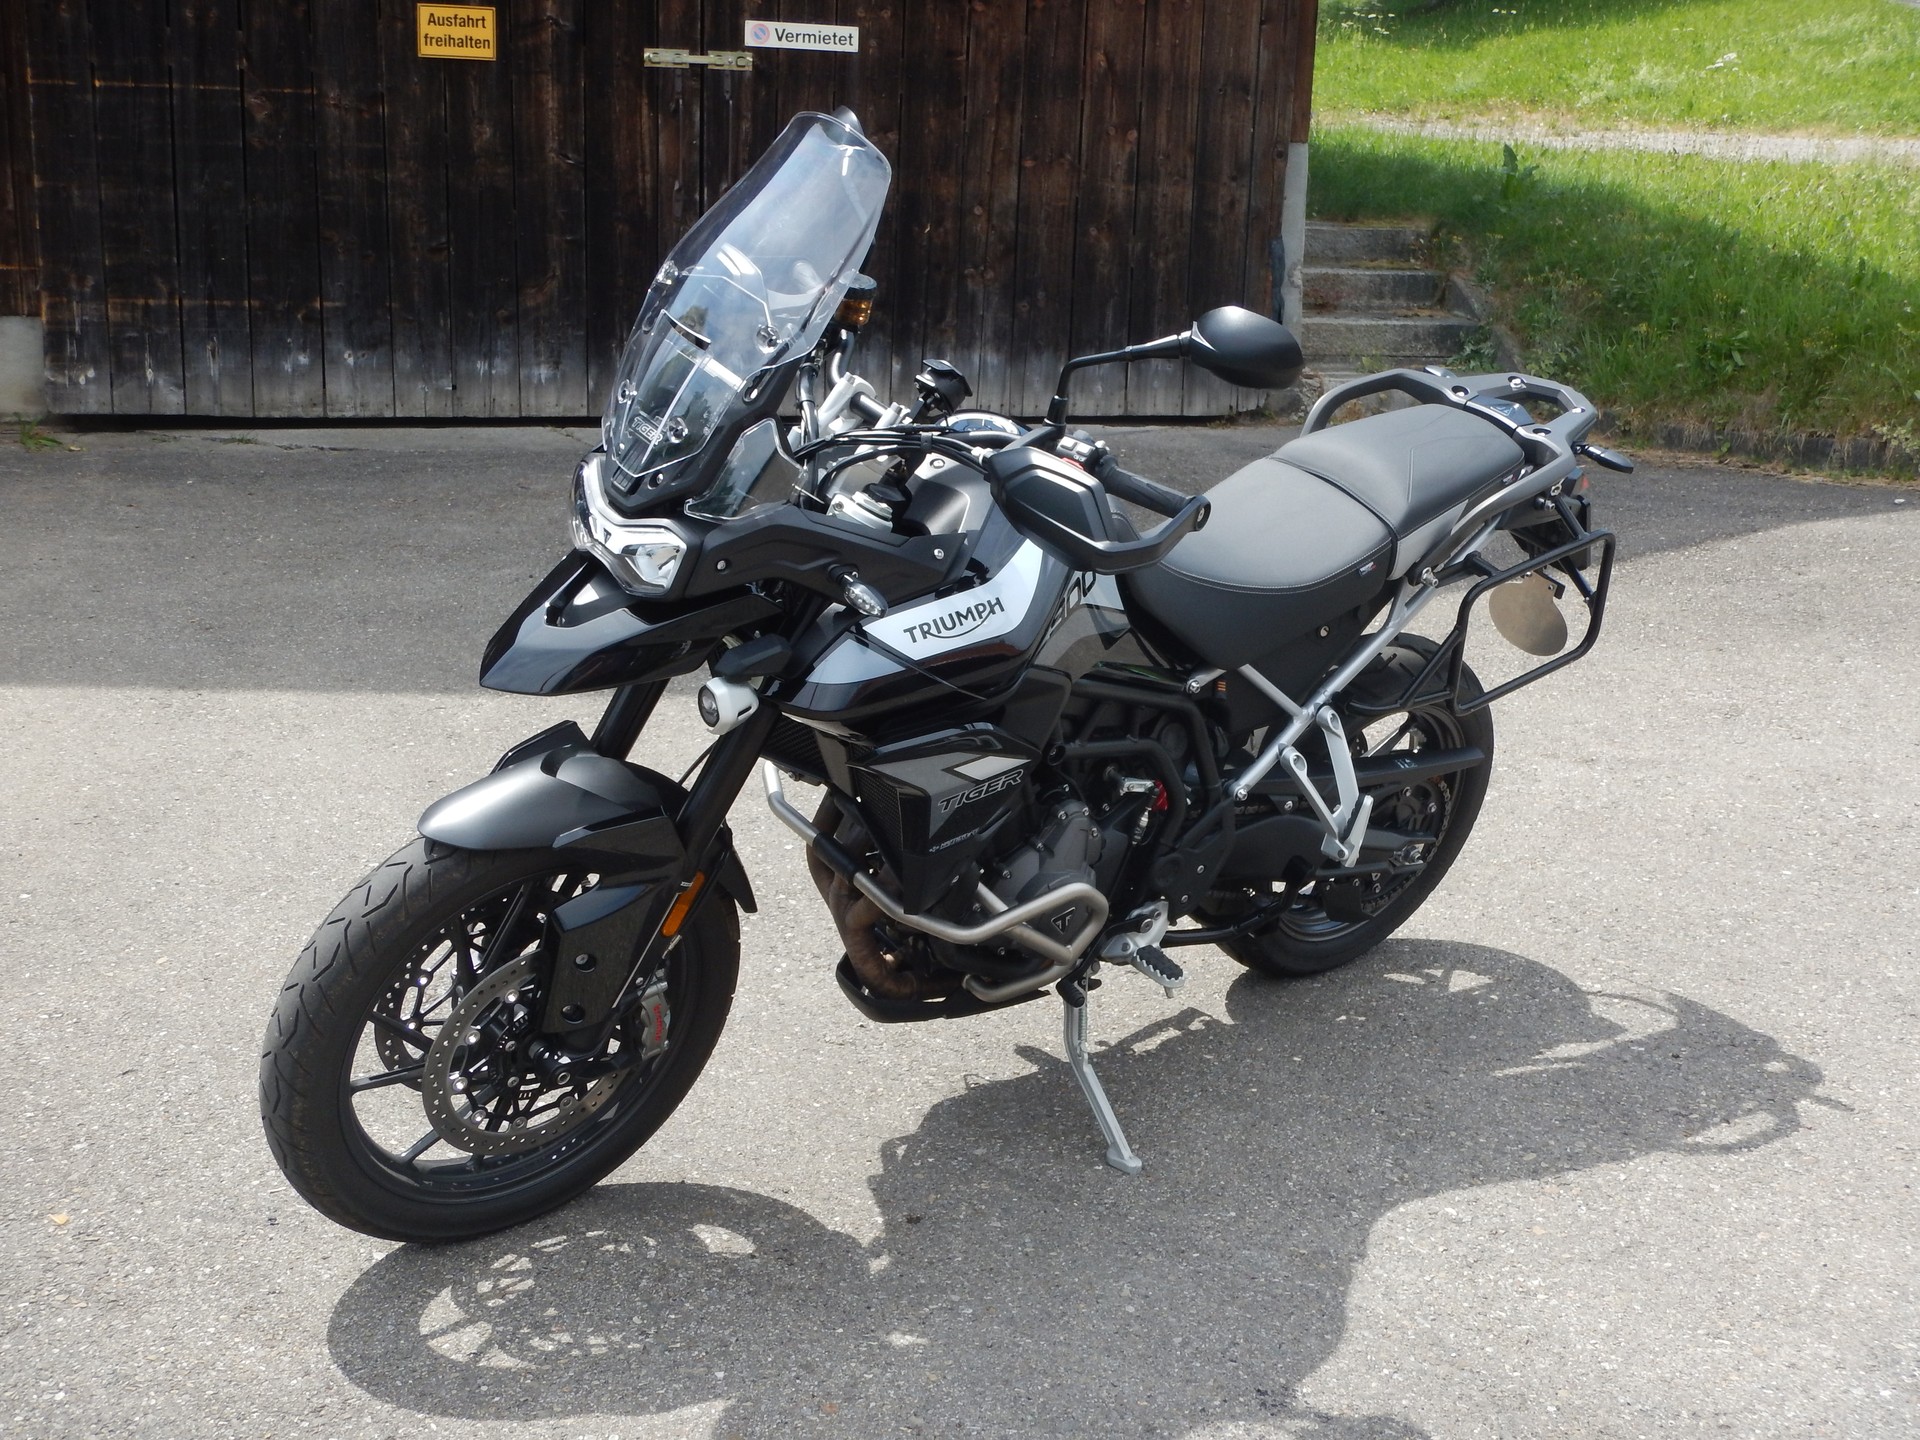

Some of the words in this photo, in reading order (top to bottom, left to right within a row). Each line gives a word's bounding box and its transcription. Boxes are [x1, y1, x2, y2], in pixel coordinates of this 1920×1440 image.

[427, 12, 487, 29] Ausfahrt
[423, 33, 491, 49] freihalten
[774, 27, 854, 46] Vermietet
[631, 416, 664, 446] TIGER
[902, 597, 1005, 643] TRIUMPH
[937, 769, 1024, 813] TIGER
